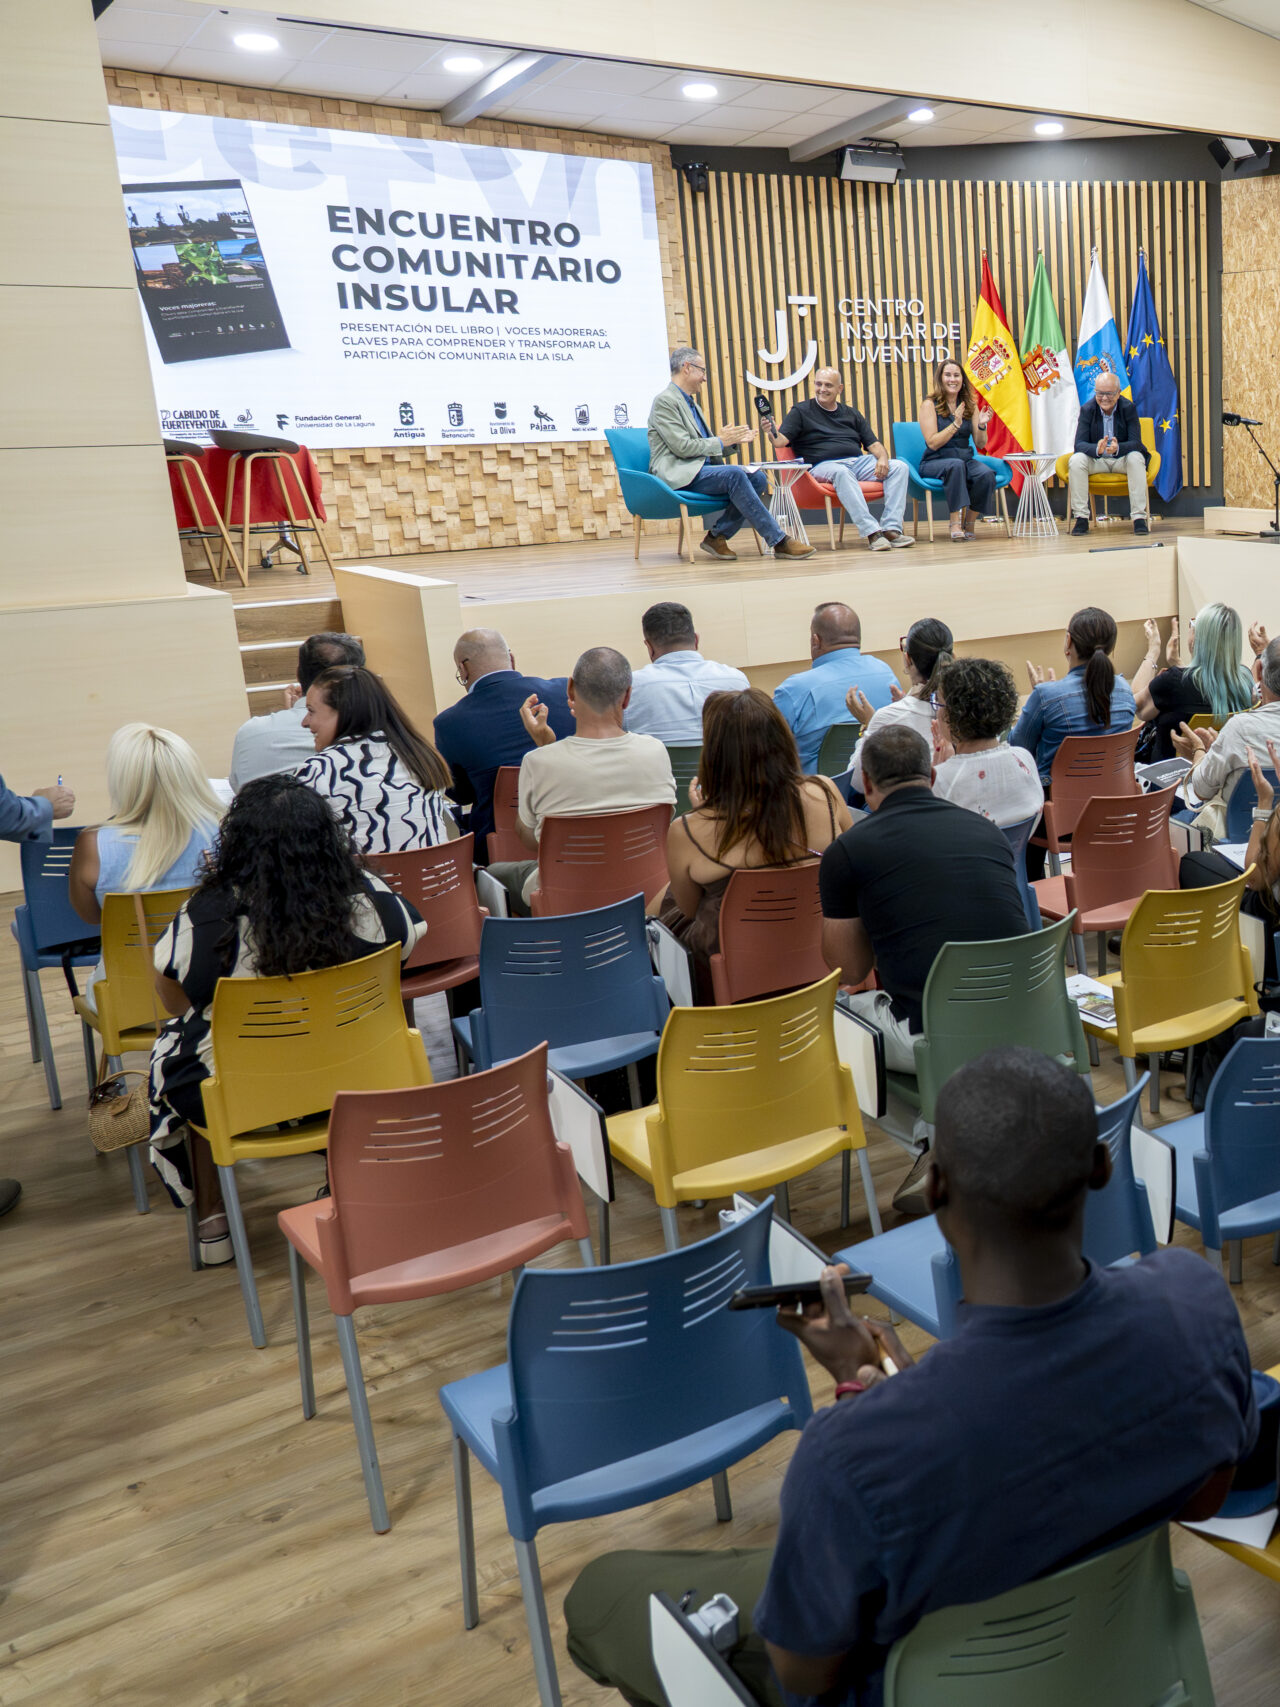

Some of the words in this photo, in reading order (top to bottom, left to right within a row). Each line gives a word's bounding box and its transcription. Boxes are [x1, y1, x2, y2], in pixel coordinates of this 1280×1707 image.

[327, 205, 580, 247] ENCUENTRO
[331, 244, 622, 284] COMUNITARIO
[337, 282, 520, 314] INSULAR
[838, 299, 924, 317] CENTRO
[340, 323, 432, 333] PRESENTACIÓN
[435, 325, 457, 333] DEL
[460, 326, 493, 334] LIBRO
[505, 326, 541, 335] VOCES
[543, 328, 607, 337] MAJORERAS:
[840, 322, 927, 339] INSULAR
[932, 322, 961, 340] DE
[342, 336, 388, 345] CLAVES
[391, 337, 423, 346] PARA
[426, 338, 506, 347] COMPRENDER
[509, 339, 515, 348] Y
[518, 339, 596, 348] TRANSFORMAR
[598, 341, 611, 349] LA
[344, 350, 435, 360] PARTICIPACIÓN
[439, 351, 516, 360] COMUNITARIA
[519, 352, 533, 360] EN
[536, 353, 549, 361] LA
[552, 353, 574, 361] ISLA
[841, 345, 950, 363] JUVENTUD
[173, 410, 208, 419] CABILDO
[209, 410, 220, 419] DE
[162, 420, 228, 429] FUERTEVENTURA
[499, 426, 516, 434] Oliva
[530, 423, 556, 431] Pájara
[393, 431, 426, 439] Antigua
